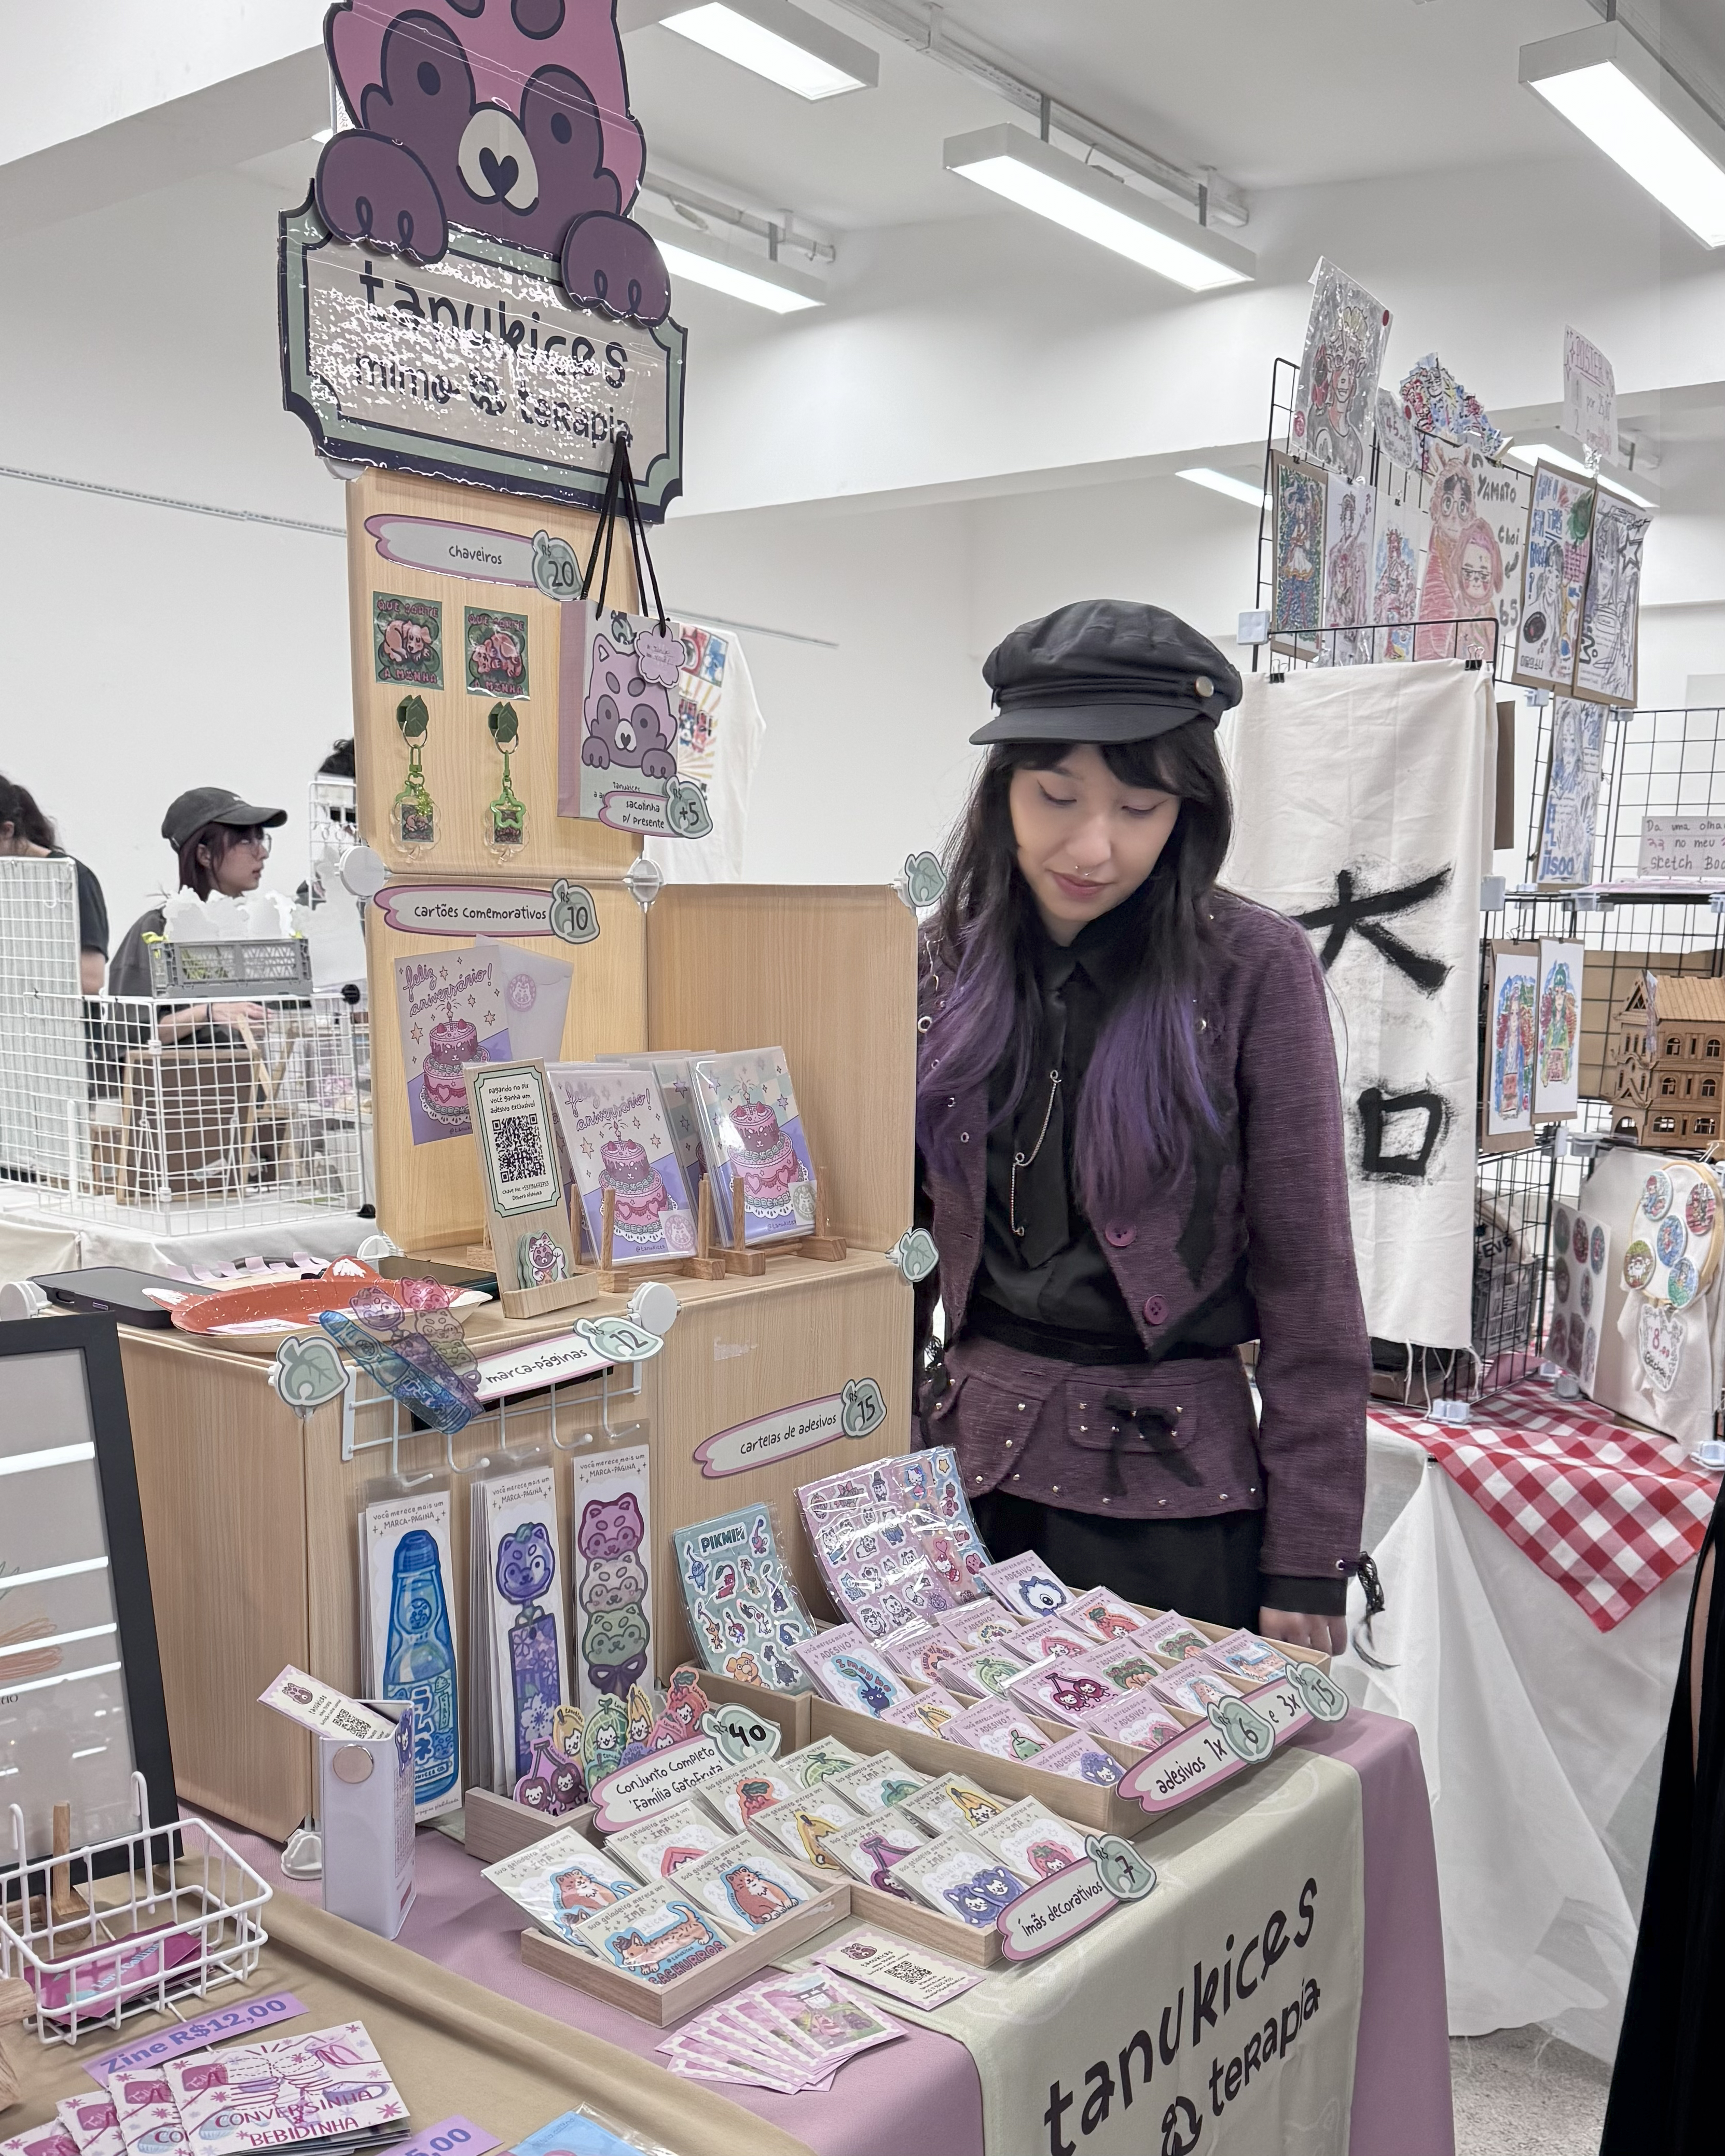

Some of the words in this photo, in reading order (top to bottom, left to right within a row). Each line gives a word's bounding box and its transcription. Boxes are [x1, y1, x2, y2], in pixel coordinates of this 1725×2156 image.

[360, 261, 628, 389] tanukices
[1478, 474, 1516, 503] YAMATO
[448, 545, 503, 565] chaveiros
[542, 546, 551, 556] R$
[548, 561, 575, 587] 20
[377, 599, 401, 612] QUE
[405, 603, 438, 617] SORTE
[468, 615, 489, 625] QUE
[673, 787, 682, 800] R$
[626, 800, 660, 812] sacolinha
[623, 813, 630, 823] p/
[633, 817, 665, 828] presente
[1647, 819, 1662, 832] Da
[1700, 820, 1725, 831] olha
[1675, 839, 1686, 848] no
[1694, 839, 1715, 848] meu
[1539, 849, 1574, 880] jisoo
[1704, 856, 1725, 870] Boo
[560, 892, 570, 903] R$
[568, 906, 588, 931] 10
[403, 964, 437, 1002] feliz
[489, 1085, 512, 1094] pagando
[610, 1329, 648, 1350] 12
[486, 1348, 588, 1384] marca-páginas
[849, 1391, 858, 1403] R$
[857, 1395, 875, 1423] 15
[740, 1433, 781, 1455] cartelas
[784, 1426, 795, 1441] de
[798, 1414, 837, 1435] adesivos
[580, 1460, 595, 1469] você
[596, 1458, 618, 1467] merece
[589, 1462, 636, 1477] MARCA-PÁGINA
[502, 1486, 543, 1504] MARCA-PÁGINA
[373, 1510, 389, 1520] você
[390, 1508, 416, 1517] merece
[417, 1503, 432, 1511] mais
[384, 1511, 434, 1529] MARCA-PÁGINA
[700, 1526, 746, 1554] PIKMIN
[1027, 1627, 1050, 1641] ADESIVO
[820, 1641, 852, 1660] ADESIVO
[1310, 1679, 1336, 1707] 15
[1119, 1708, 1144, 1726] ADESIVO
[1268, 1709, 1280, 1723] e
[1276, 1693, 1301, 1718] 3x
[729, 1722, 767, 1747] 40
[980, 1718, 1007, 1733] ADESIVO
[1239, 1718, 1259, 1744] 6
[1053, 1750, 1080, 1769] ADESIVO
[1155, 1756, 1206, 1794] adesivos
[1203, 1738, 1228, 1762] 1x
[616, 1768, 668, 1794] Conjunto
[669, 1747, 715, 1771] Completo
[1114, 1855, 1135, 1884] 7
[1047, 1878, 1103, 1923] decorativos
[1044, 1877, 1318, 2156] tanukices
[100, 2042, 169, 2074] Zine
[169, 2000, 287, 2046] R$12,00
[215, 2091, 374, 2127] CONVERSINHA
[250, 2117, 358, 2147] BEBIDINHA
